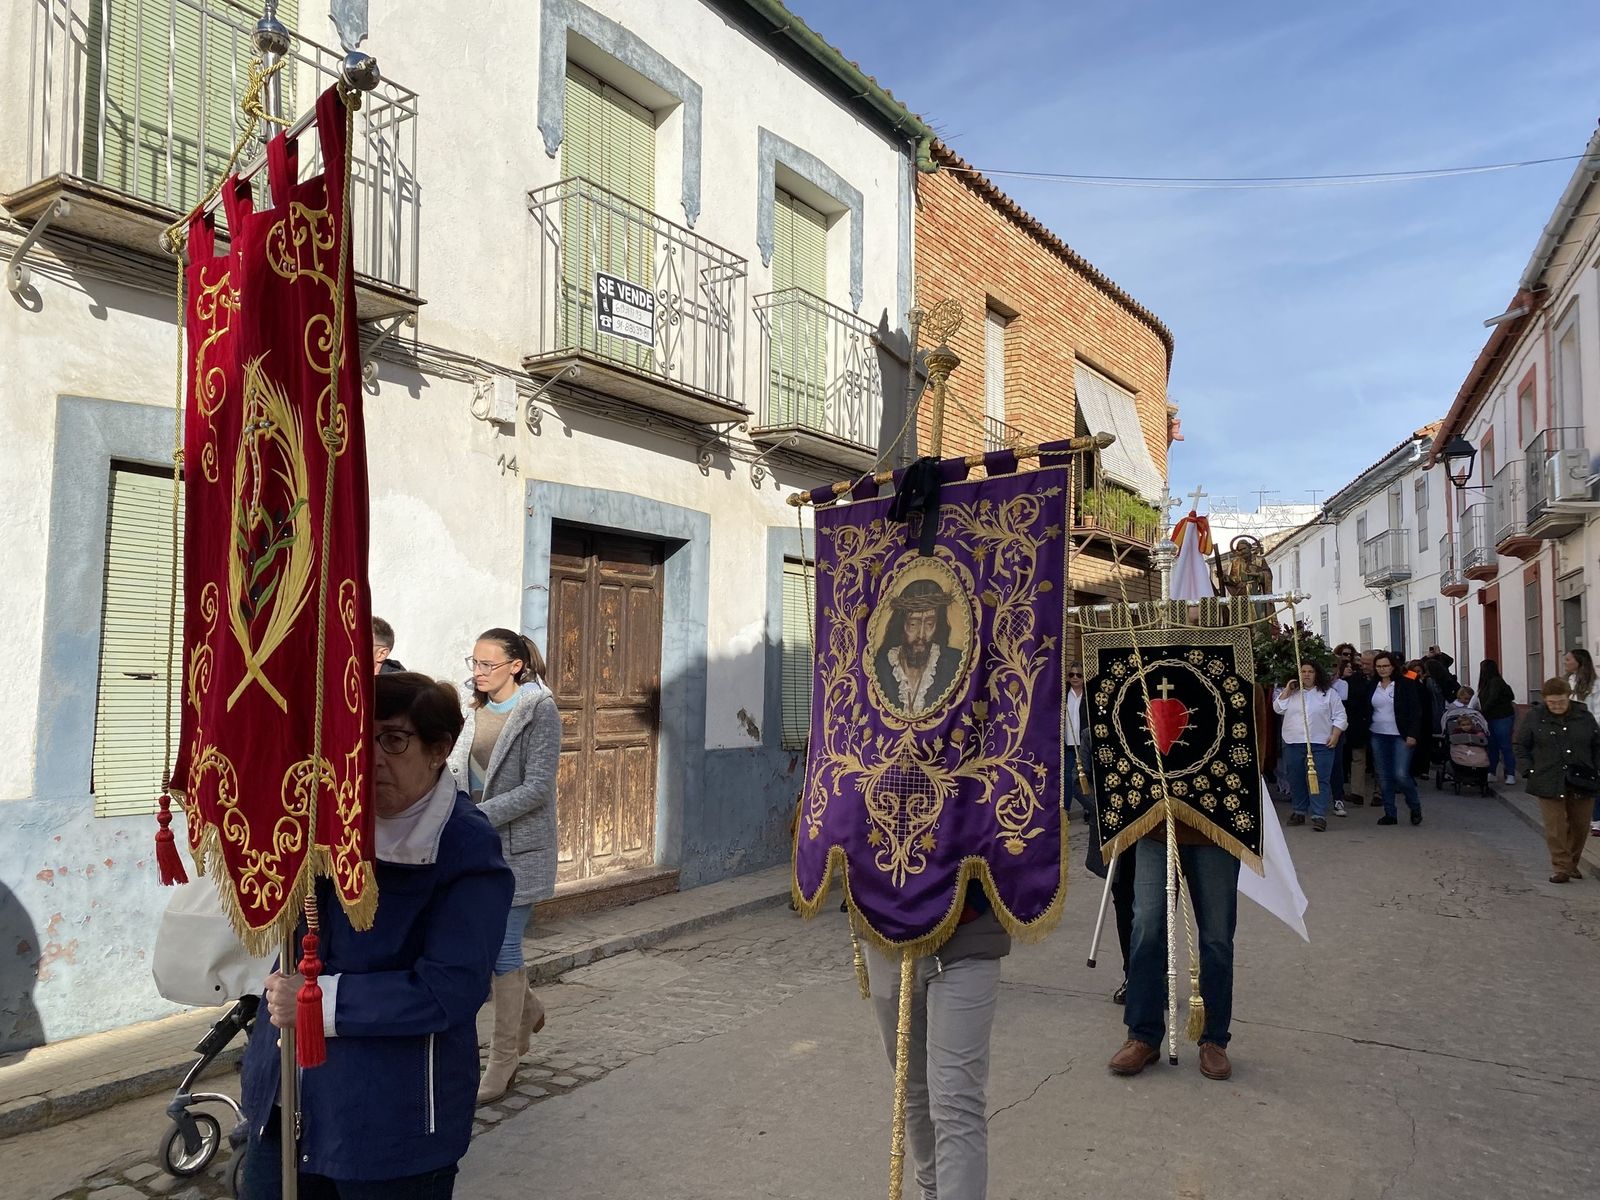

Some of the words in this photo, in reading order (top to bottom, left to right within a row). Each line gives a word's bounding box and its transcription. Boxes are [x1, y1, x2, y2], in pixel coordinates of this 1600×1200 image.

[599, 276, 615, 297] SE
[617, 282, 653, 311] VENDE
[497, 453, 520, 477] 14
